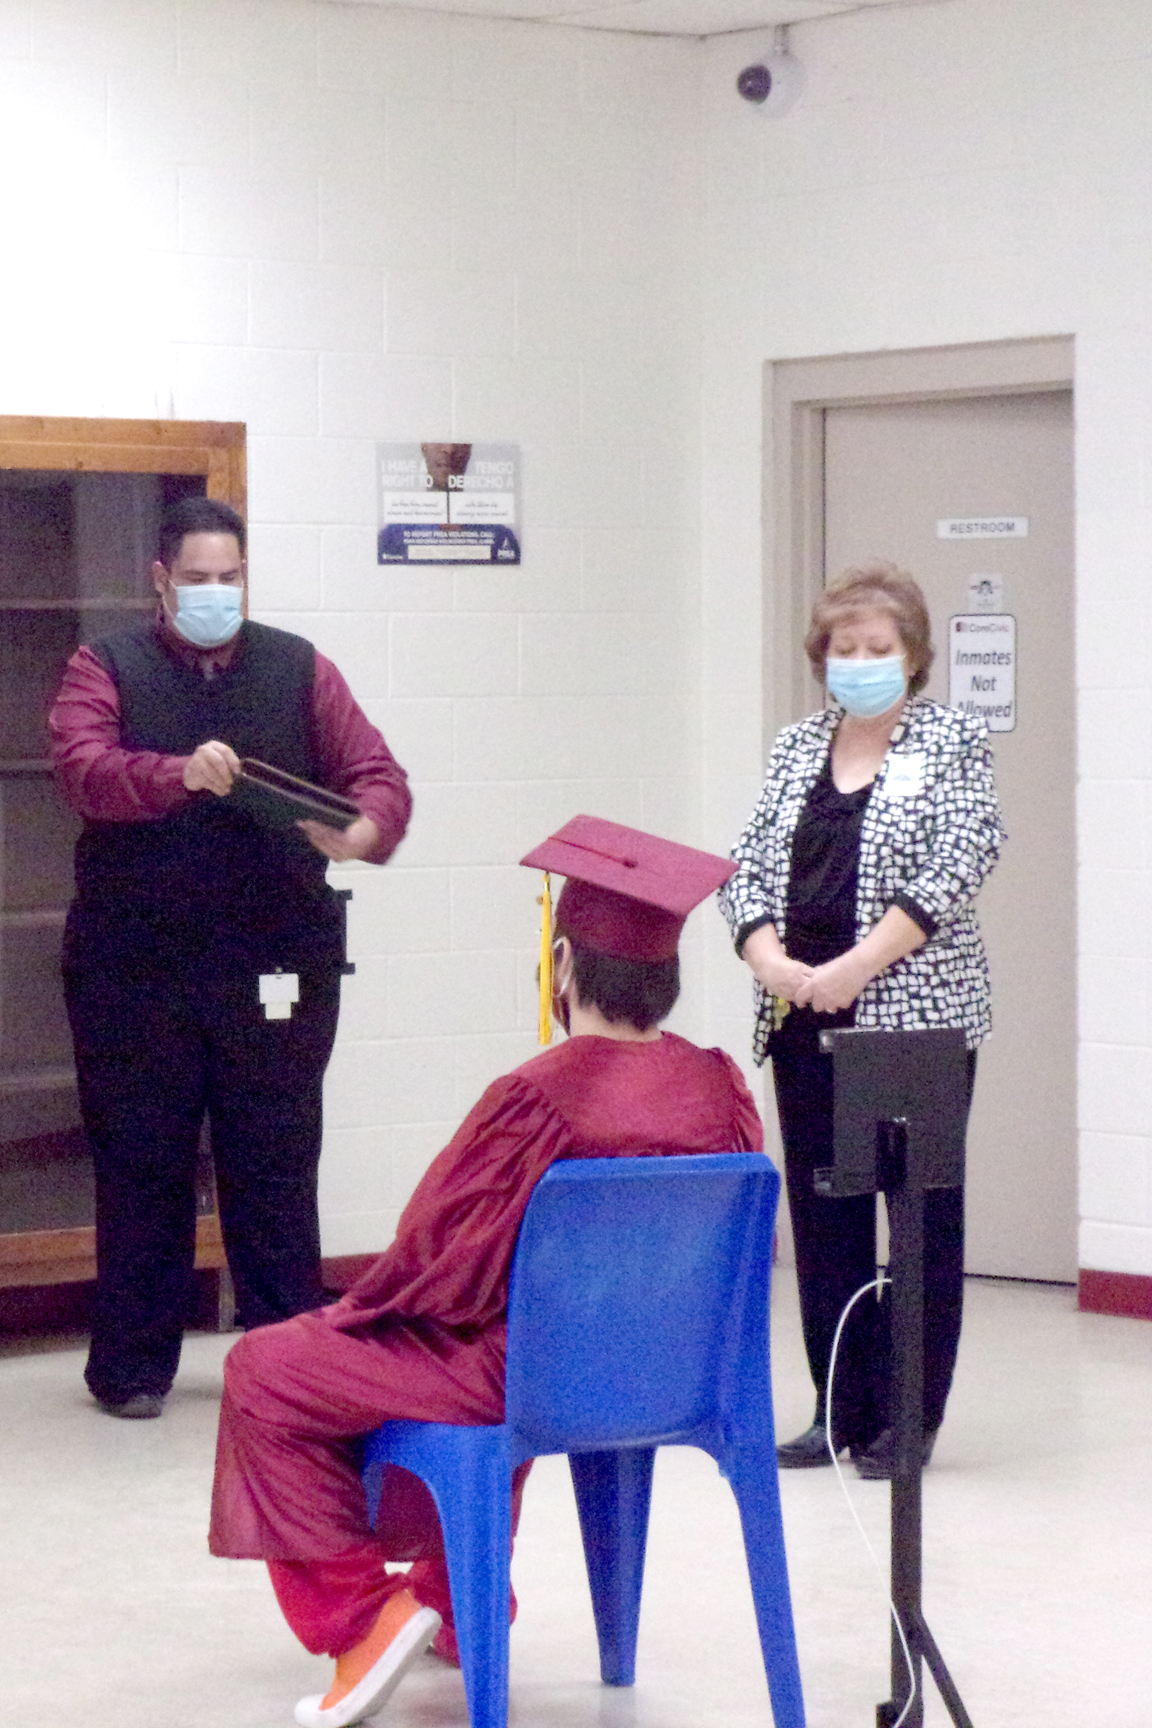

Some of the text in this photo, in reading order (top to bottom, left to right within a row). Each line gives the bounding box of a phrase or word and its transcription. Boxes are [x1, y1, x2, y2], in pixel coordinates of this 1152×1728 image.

[388, 461, 417, 473] HAVE
[475, 461, 514, 474] TENGO
[382, 475, 433, 488] RIGHT TO
[448, 475, 515, 488] DERECHO A
[950, 522, 1015, 533] RESTROOM
[956, 649, 1012, 666] Inmates
[971, 675, 997, 691] Not
